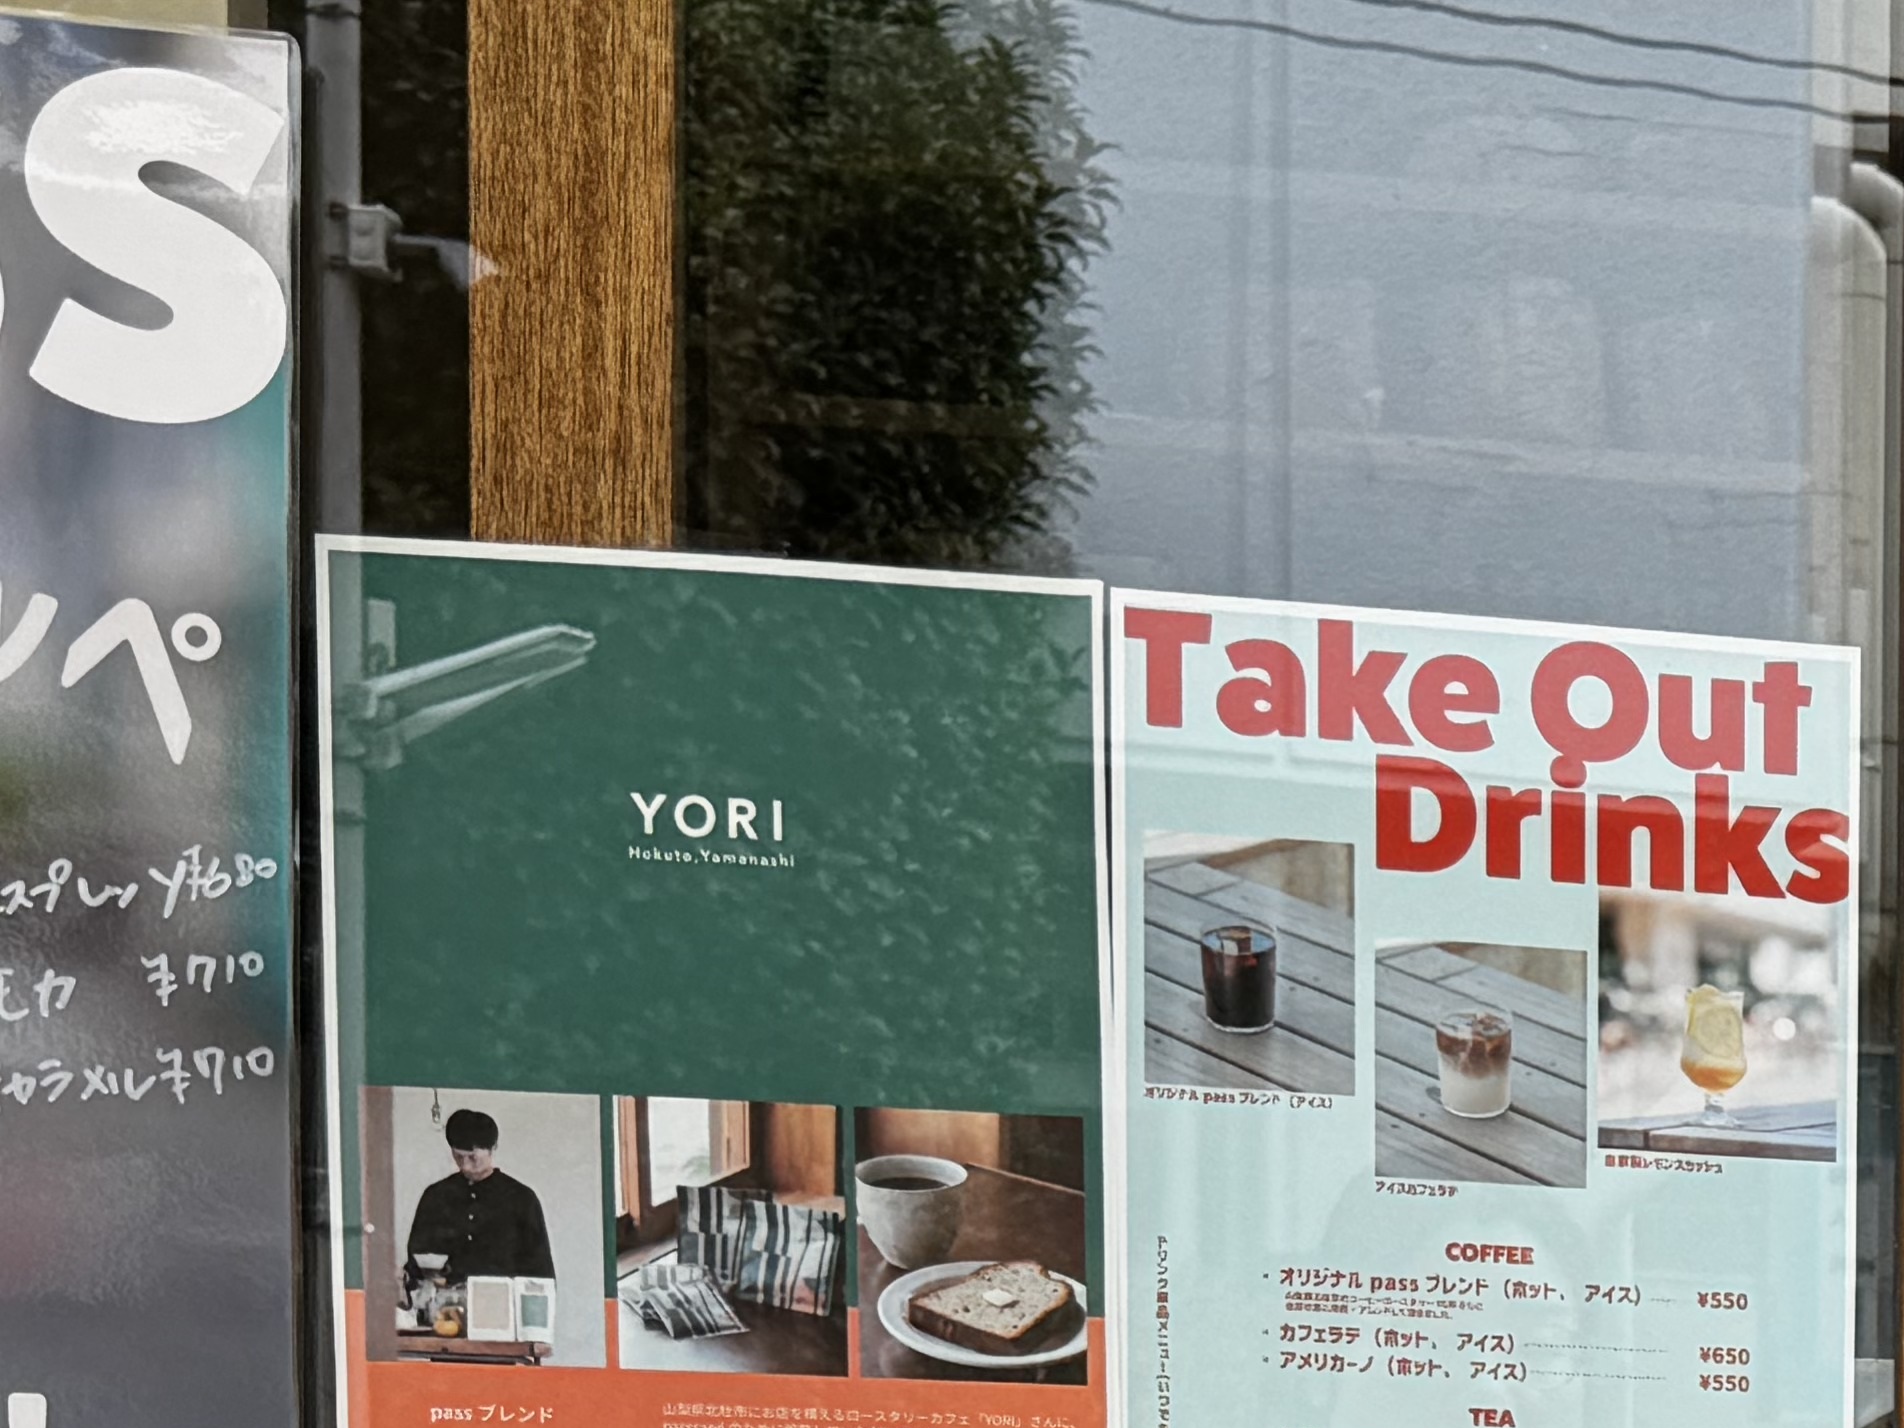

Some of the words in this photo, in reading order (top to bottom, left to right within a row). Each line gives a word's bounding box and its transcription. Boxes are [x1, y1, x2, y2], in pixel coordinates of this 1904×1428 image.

[0, 66, 287, 424] S
[1125, 605, 1500, 752] Take
[1530, 641, 1812, 776] Out
[630, 792, 784, 842] YORI
[1375, 754, 1849, 904] Drinks
[141, 951, 264, 1006] ¥710
[0, 1059, 156, 1104] ャラメル
[156, 1047, 274, 1104] ¥710
[1445, 1242, 1534, 1265] COFFEE
[1280, 1267, 1362, 1289] オリジナル
[1370, 1273, 1419, 1293] pass
[1426, 1274, 1489, 1295] ブレンド
[1697, 1291, 1748, 1310] ¥550
[1280, 1324, 1360, 1345] カフェラテ
[1699, 1347, 1750, 1366] ¥650
[1280, 1351, 1374, 1373] アメリカーノ
[1699, 1373, 1750, 1393] ¥550
[430, 1406, 472, 1423] pass
[478, 1404, 553, 1424] ブレンド
[1468, 1408, 1515, 1428] TEA
